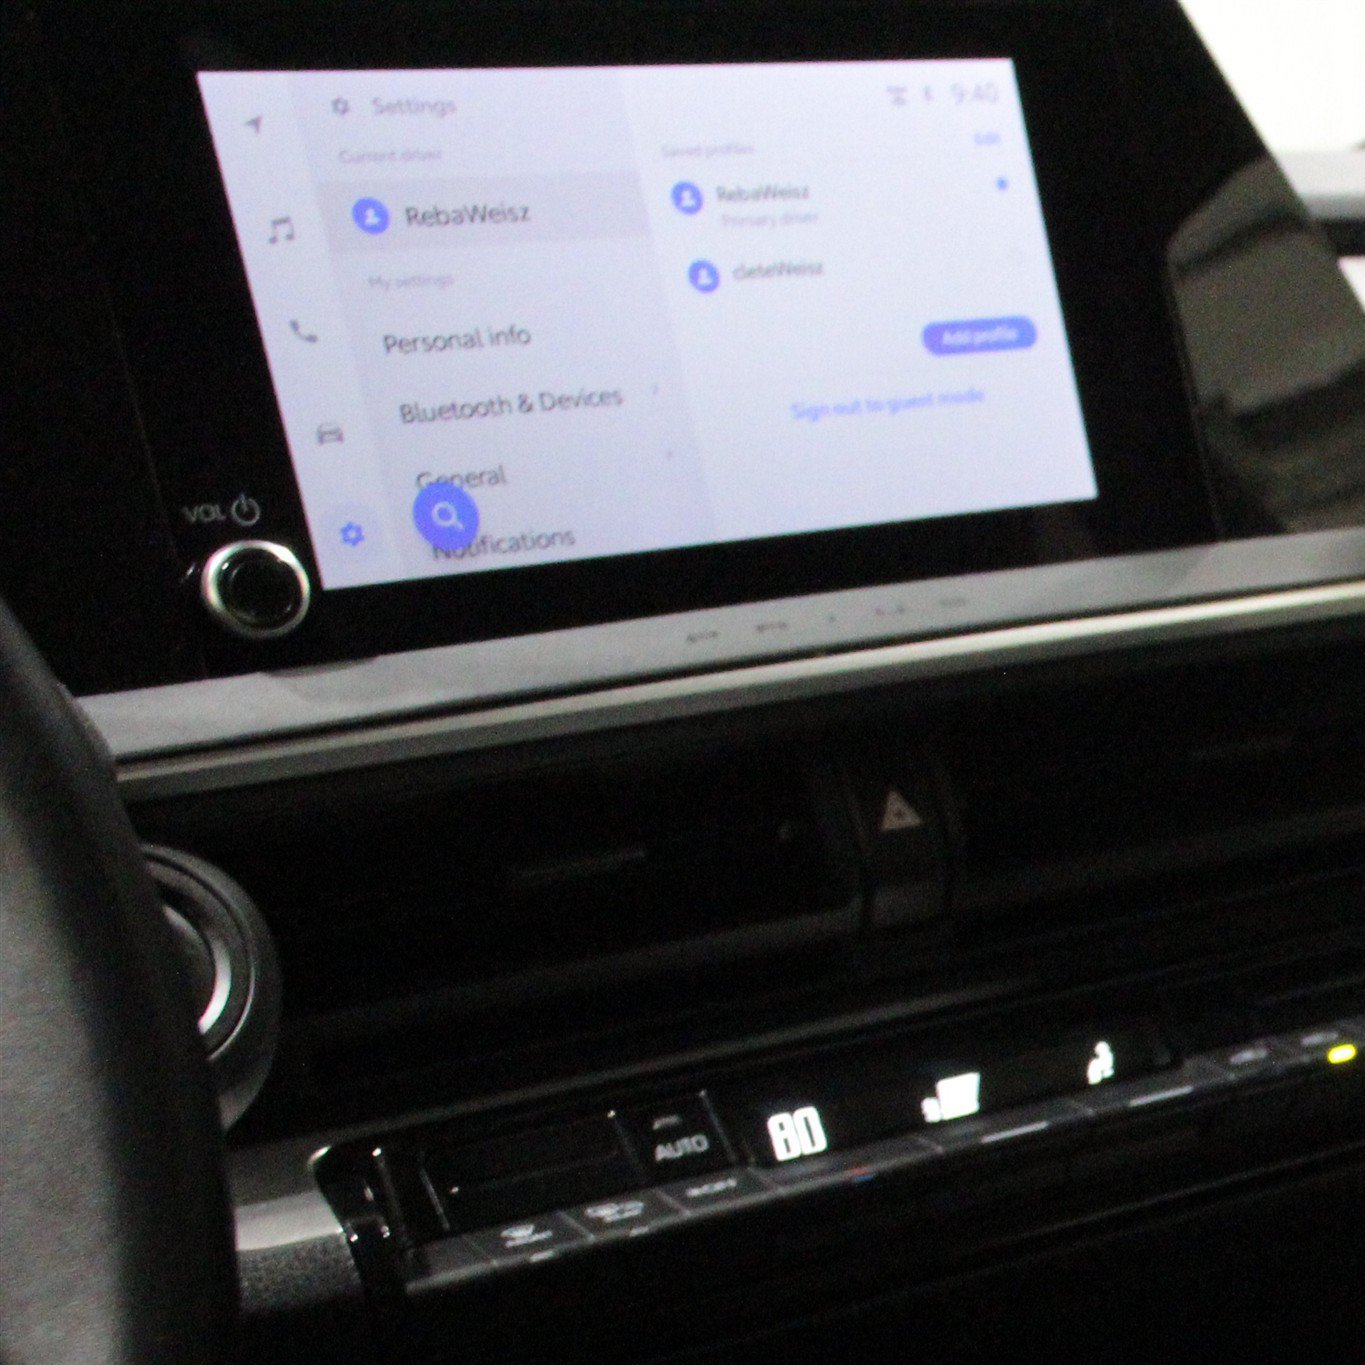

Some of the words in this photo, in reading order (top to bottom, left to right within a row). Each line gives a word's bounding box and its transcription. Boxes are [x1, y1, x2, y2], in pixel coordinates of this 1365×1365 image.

[372, 96, 457, 118] Settings
[715, 184, 810, 201] RebaWeisz
[404, 202, 532, 227] RebaWeisz
[383, 326, 483, 356] Personal
[488, 324, 533, 349] info
[400, 394, 511, 425] Bluetooth
[518, 388, 534, 413] &
[539, 385, 624, 410] Devices
[180, 502, 228, 524] VOL
[653, 1133, 709, 1162] AUTO
[766, 1106, 828, 1162] 80
